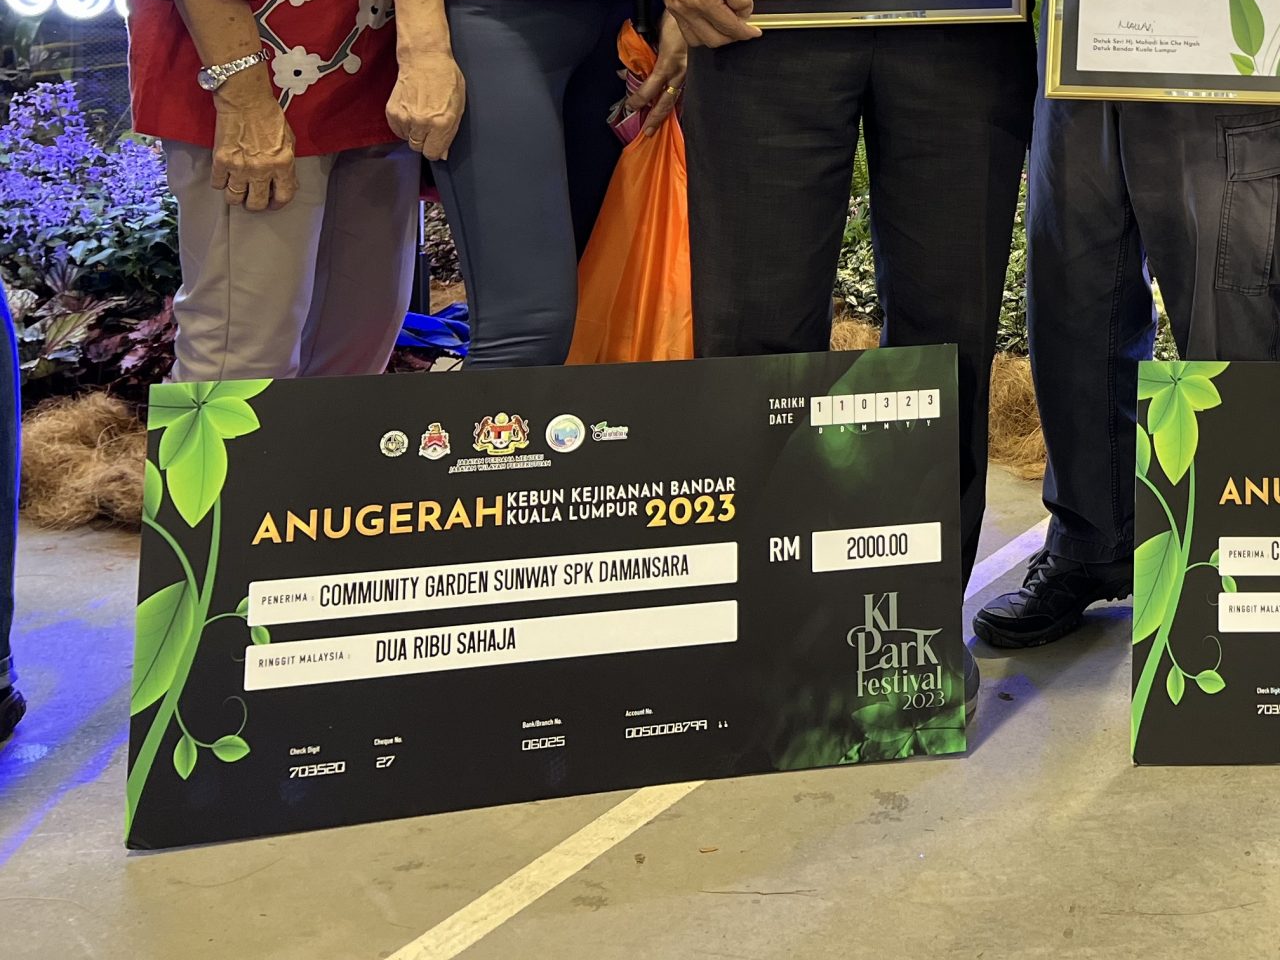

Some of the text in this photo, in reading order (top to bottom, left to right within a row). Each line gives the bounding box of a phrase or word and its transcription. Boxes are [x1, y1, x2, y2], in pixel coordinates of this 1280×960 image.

[769, 397, 805, 410] TARIKH
[769, 413, 793, 425] DATE
[507, 477, 736, 508] KEBUN KEJIRANAN BANDAR
[507, 493, 736, 528] KUALA LUMPUR 2023
[252, 496, 503, 545] ANUGERAH
[769, 532, 908, 563] RM 2000.00
[1228, 550, 1265, 559] PENERIMA
[261, 554, 689, 608] PENERIMA COMMUNITY GARDEN SUNWAY SPK DAMANSARA
[1228, 605, 1258, 614] RINGGIT
[258, 628, 516, 668] RINGGIT MALAYSIA DUA RIBU SAHAJA
[856, 666, 943, 698] Festival
[902, 691, 946, 711] 2023
[625, 708, 645, 717] Account
[625, 719, 707, 739] 0050008799
[290, 745, 320, 755] Check Digit
[522, 736, 565, 751] 06025
[289, 761, 346, 779] 703520
[376, 756, 395, 768] 27
